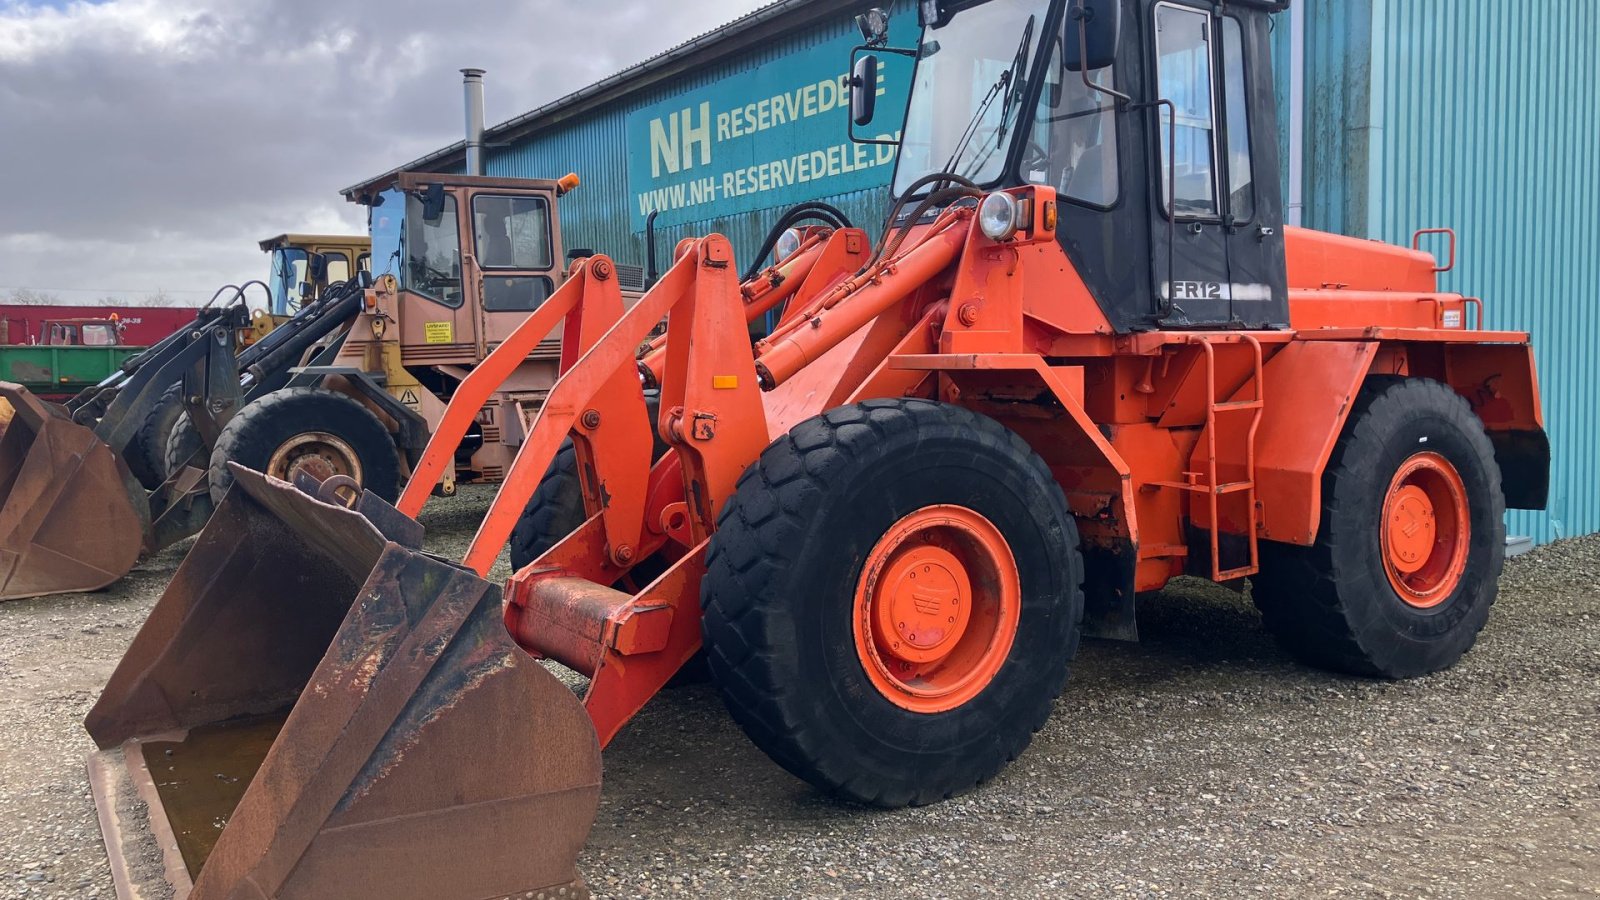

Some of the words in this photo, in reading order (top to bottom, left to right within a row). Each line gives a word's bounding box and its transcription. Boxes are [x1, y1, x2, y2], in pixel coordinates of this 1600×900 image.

[650, 101, 711, 178] NH
[717, 61, 886, 142] RESERVEDEE
[1172, 281, 1220, 298] FR12
